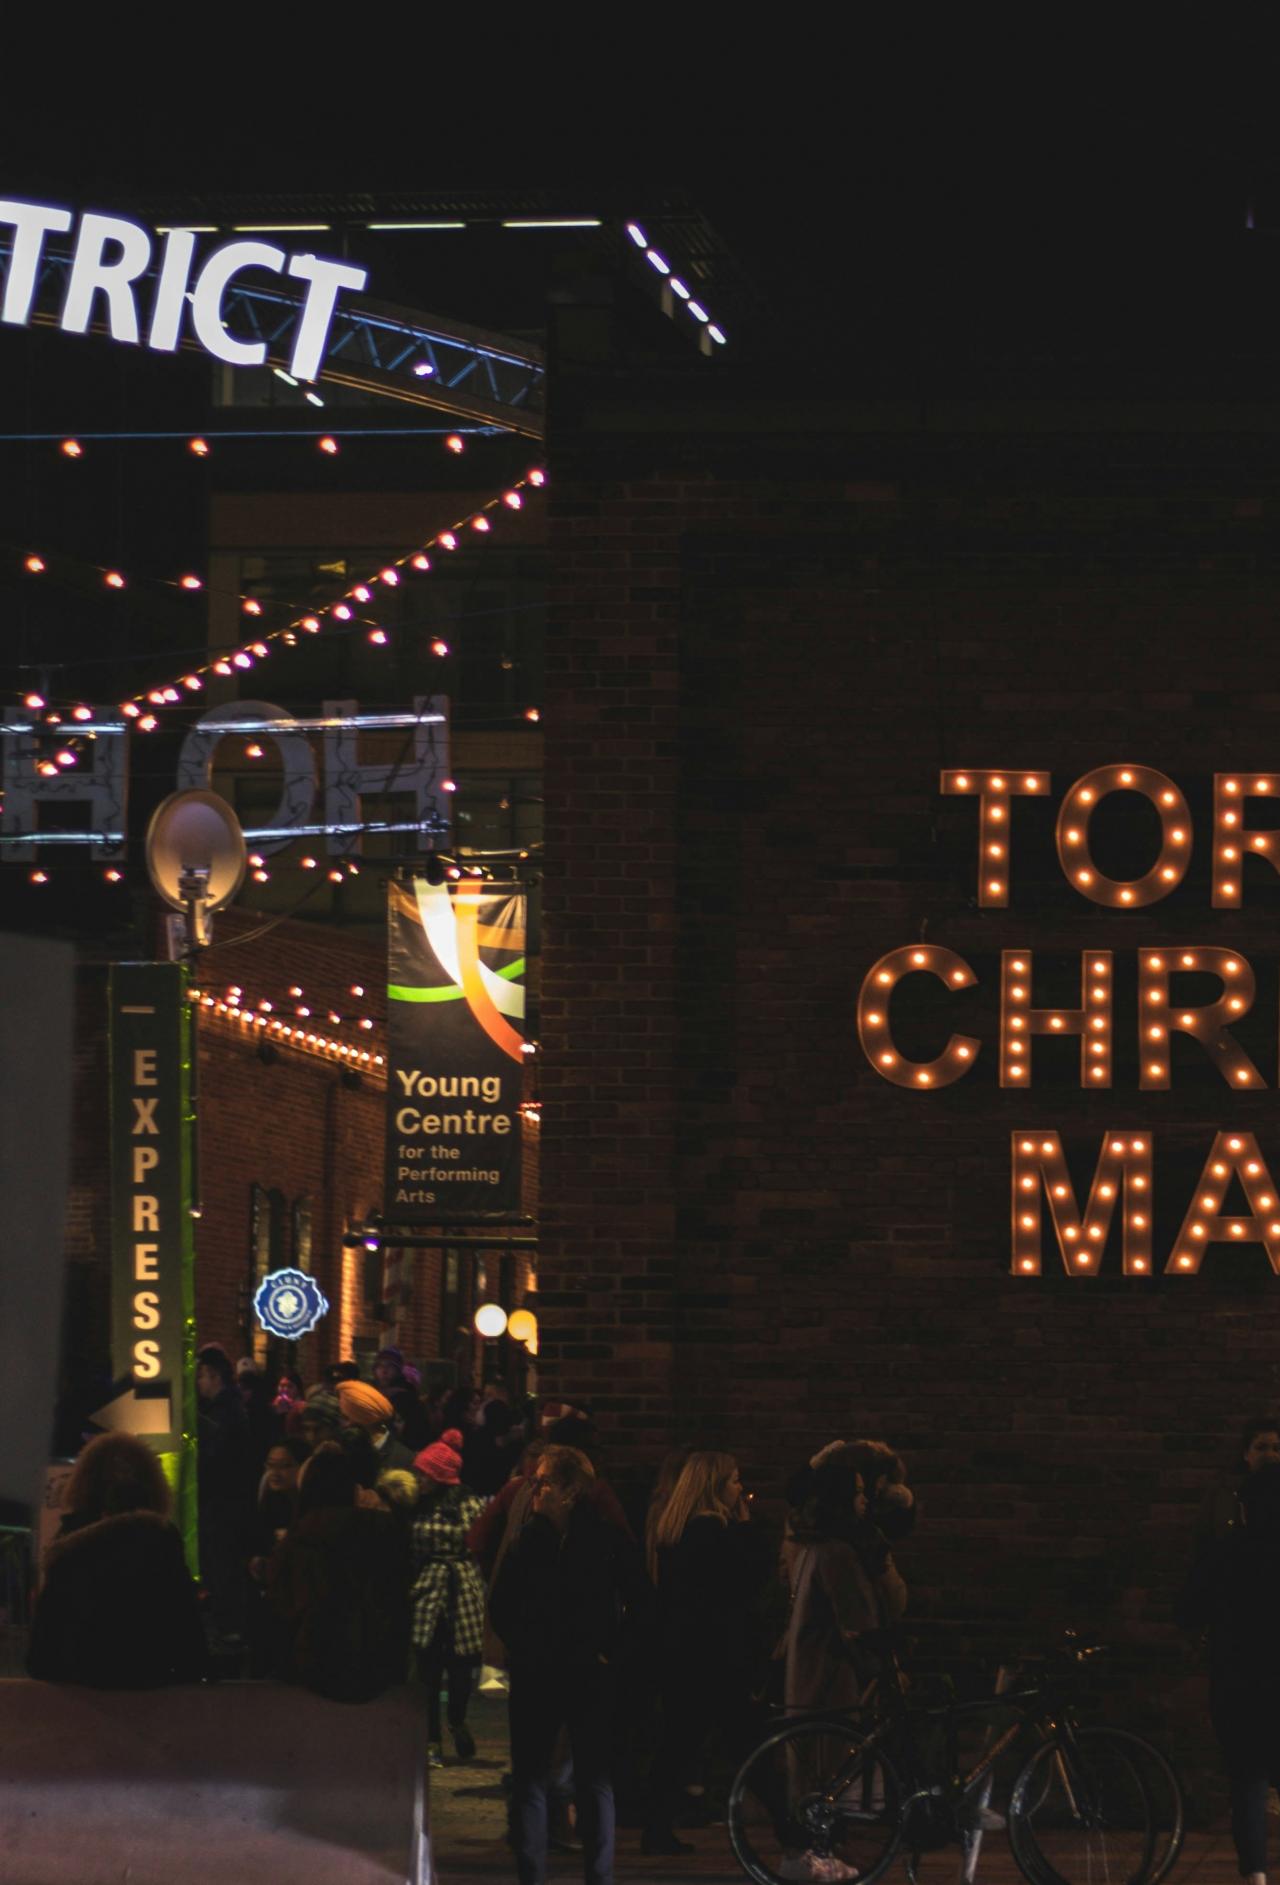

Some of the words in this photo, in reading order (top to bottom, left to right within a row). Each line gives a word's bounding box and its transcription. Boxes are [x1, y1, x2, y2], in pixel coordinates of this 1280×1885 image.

[0, 199, 367, 382] TRICT
[396, 1070, 501, 1103] Young
[396, 1107, 512, 1135] Centre
[399, 1145, 425, 1160] for
[431, 1145, 461, 1160] the
[398, 1167, 500, 1184] Performing
[396, 1189, 436, 1204] Arts
[132, 1049, 160, 1379] EXPRESS
